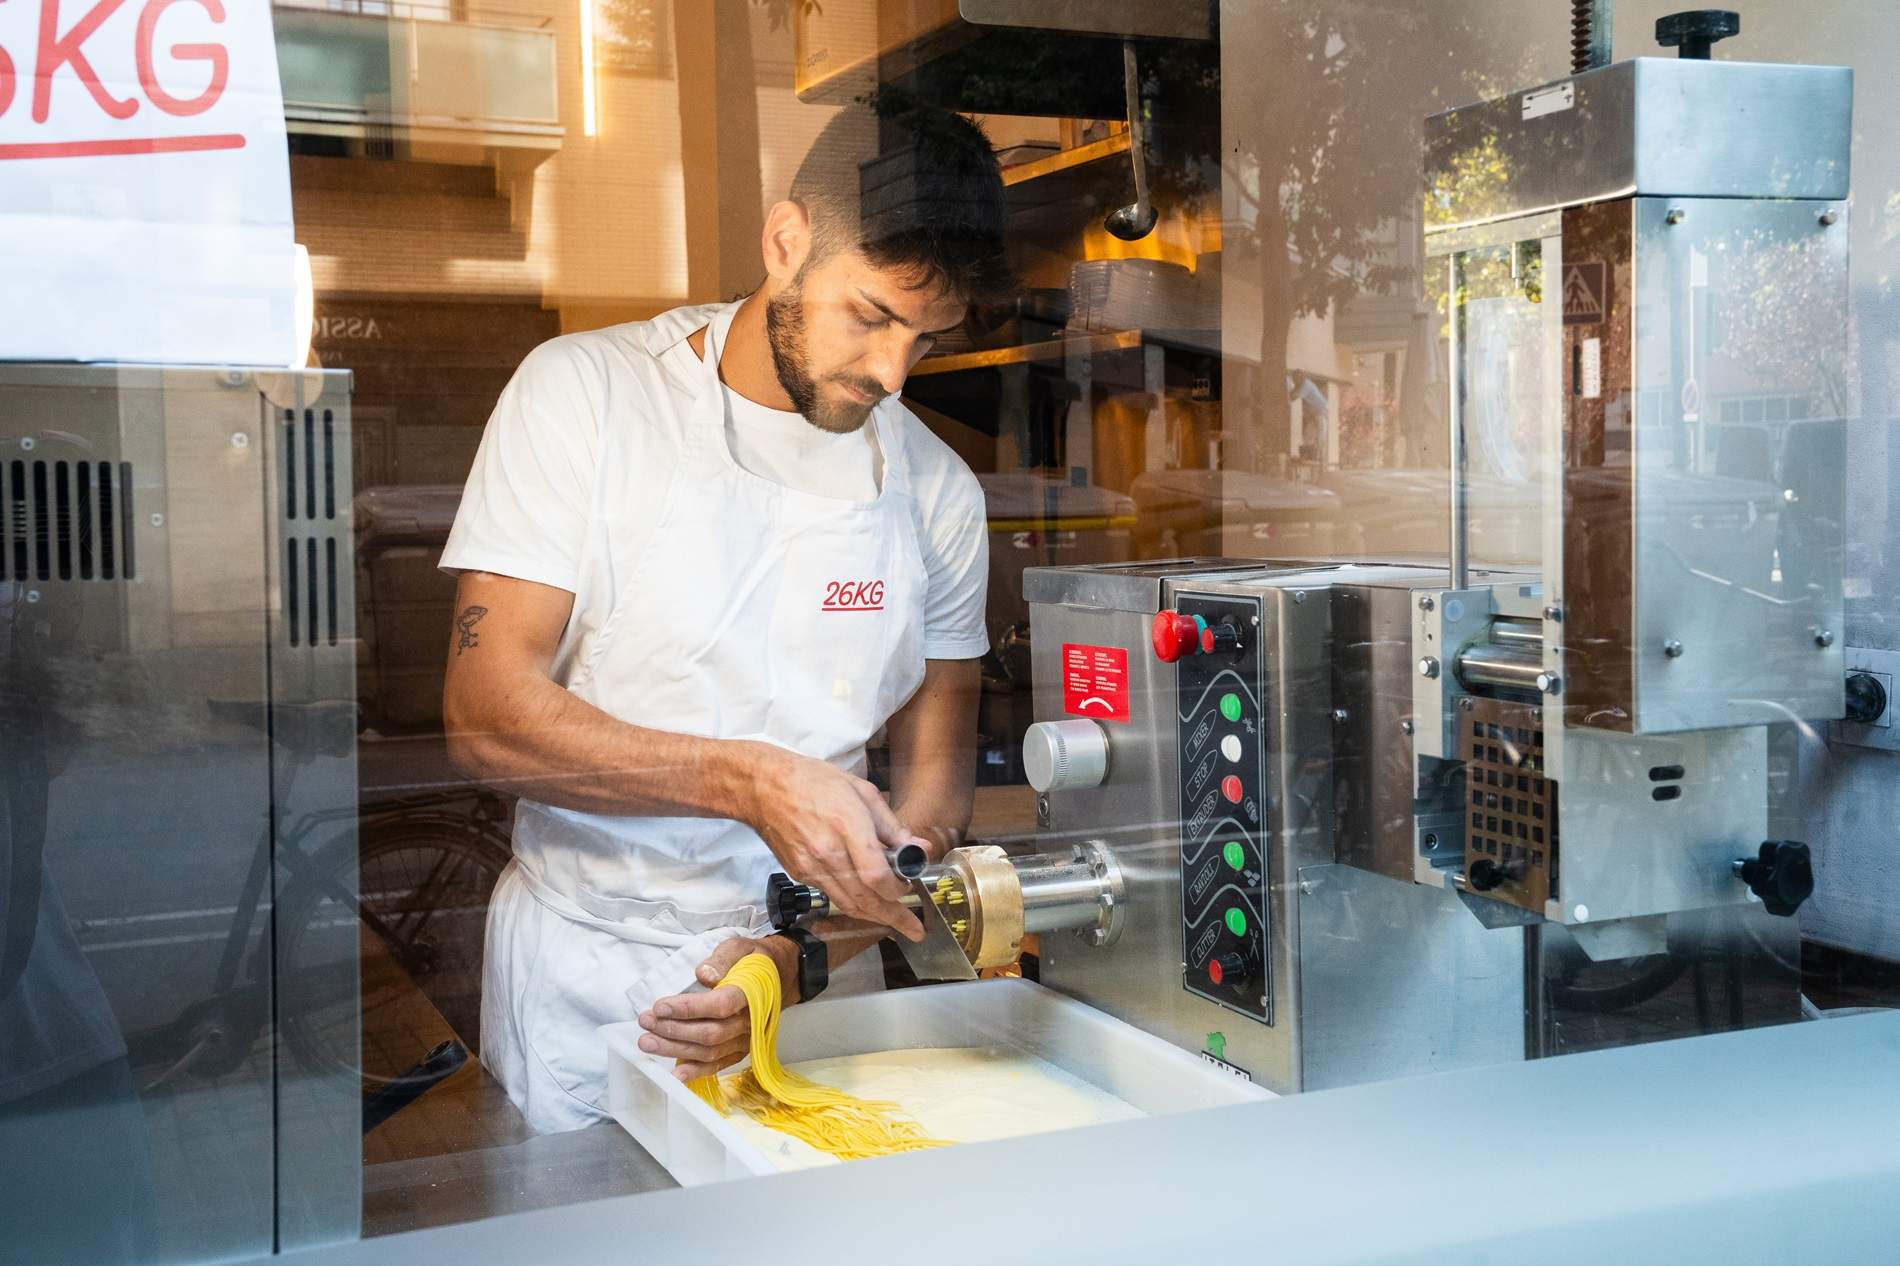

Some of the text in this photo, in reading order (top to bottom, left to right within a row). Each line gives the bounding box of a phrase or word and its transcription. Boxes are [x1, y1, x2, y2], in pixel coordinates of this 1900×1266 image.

[823, 580, 884, 606] 26KG
[1193, 722, 1209, 750] MIXER
[1194, 762, 1208, 788] STOP
[1190, 795, 1215, 834] EXTRUDER
[1195, 863, 1214, 895] RAVIOLI
[1196, 928, 1216, 959] CUTTER
